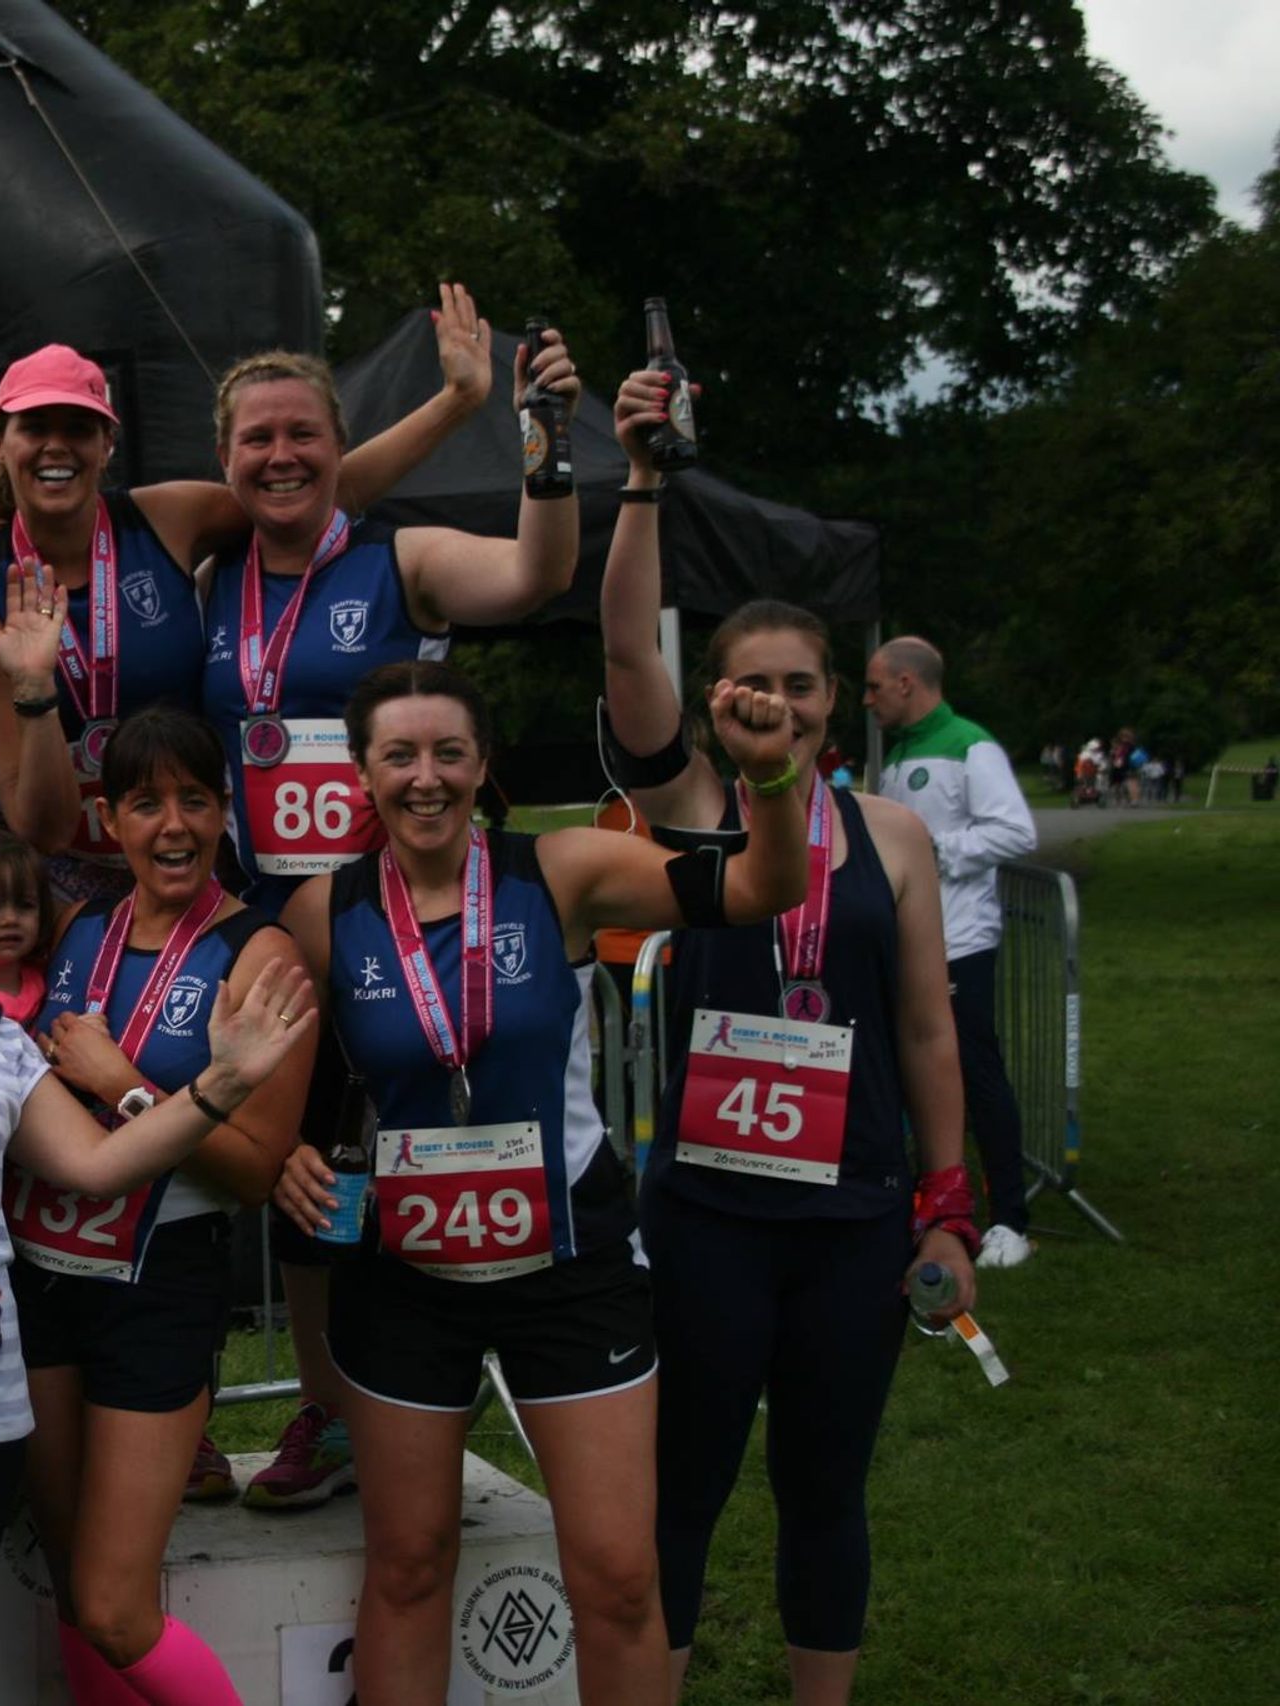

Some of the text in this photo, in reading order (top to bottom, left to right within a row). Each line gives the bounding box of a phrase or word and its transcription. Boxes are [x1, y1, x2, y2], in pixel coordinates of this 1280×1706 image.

[273, 780, 353, 840] 86
[353, 986, 397, 1000] KUKRI
[716, 1076, 804, 1143] 45
[12, 1166, 128, 1247] 132
[397, 1187, 534, 1252] 249
[461, 1585, 485, 1628] MOURNE
[483, 1566, 541, 1588] MOUNTAINS
[462, 1645, 497, 1686] BREWERY
[497, 1670, 555, 1690] MOUNTAINS
